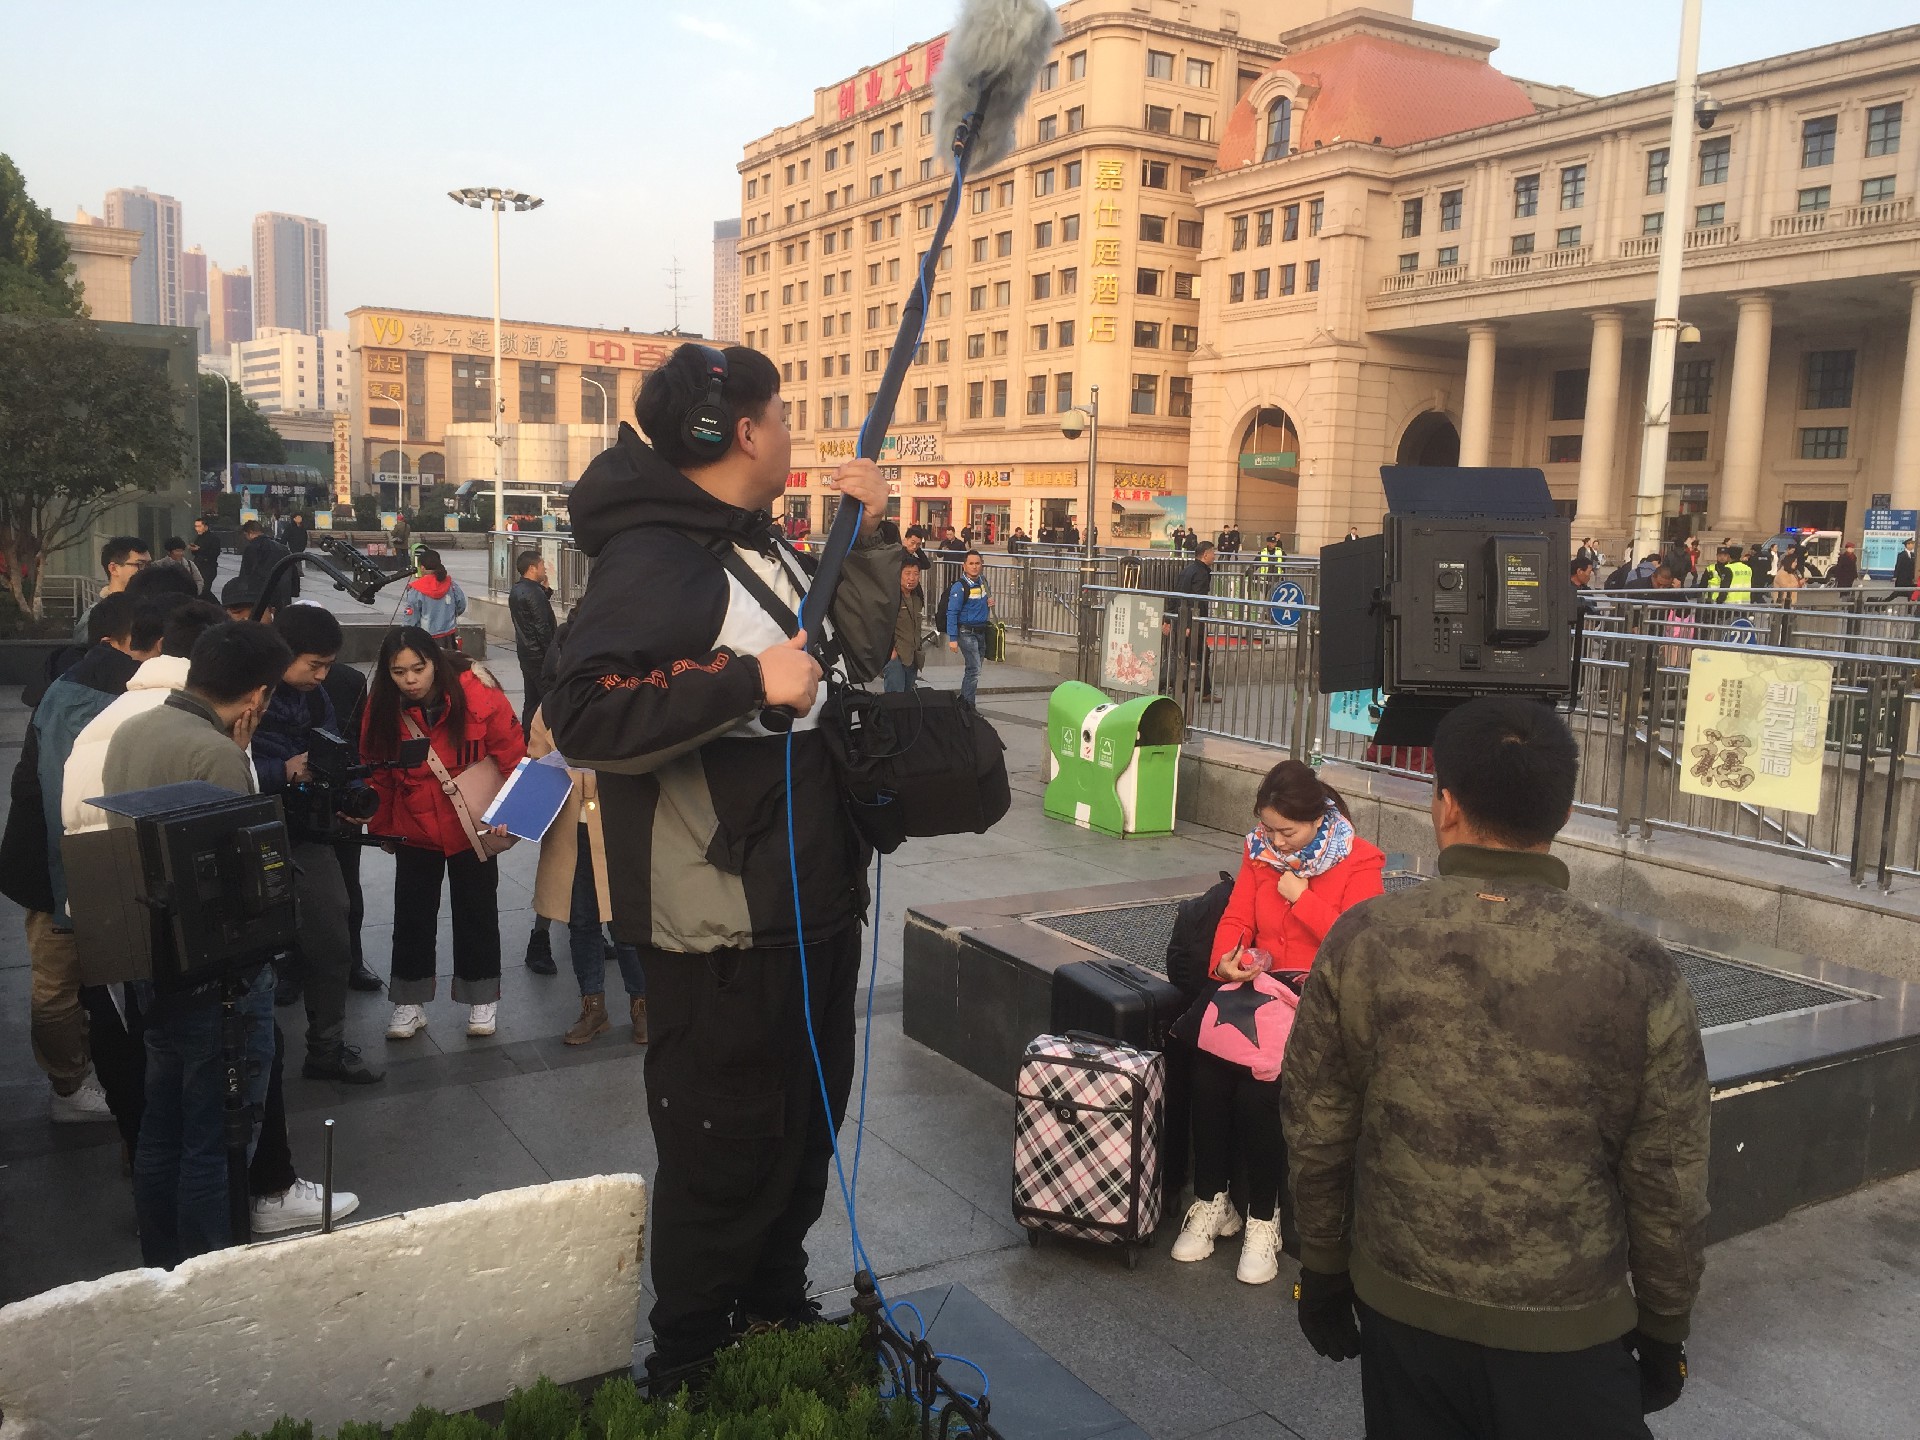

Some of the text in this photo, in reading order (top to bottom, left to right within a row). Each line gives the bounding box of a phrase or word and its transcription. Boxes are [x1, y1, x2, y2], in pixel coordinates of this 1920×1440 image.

[1087, 160, 1124, 343] 嘉仕庭酒店
[367, 315, 568, 359] V9 钻石连锁酒店
[369, 355, 401, 371] 沐足
[589, 340, 669, 369] 中百
[369, 382, 401, 398] 客房
[1278, 587, 1299, 605] 22
[1282, 609, 1291, 620] A
[1760, 683, 1798, 777] 勤劳是福
